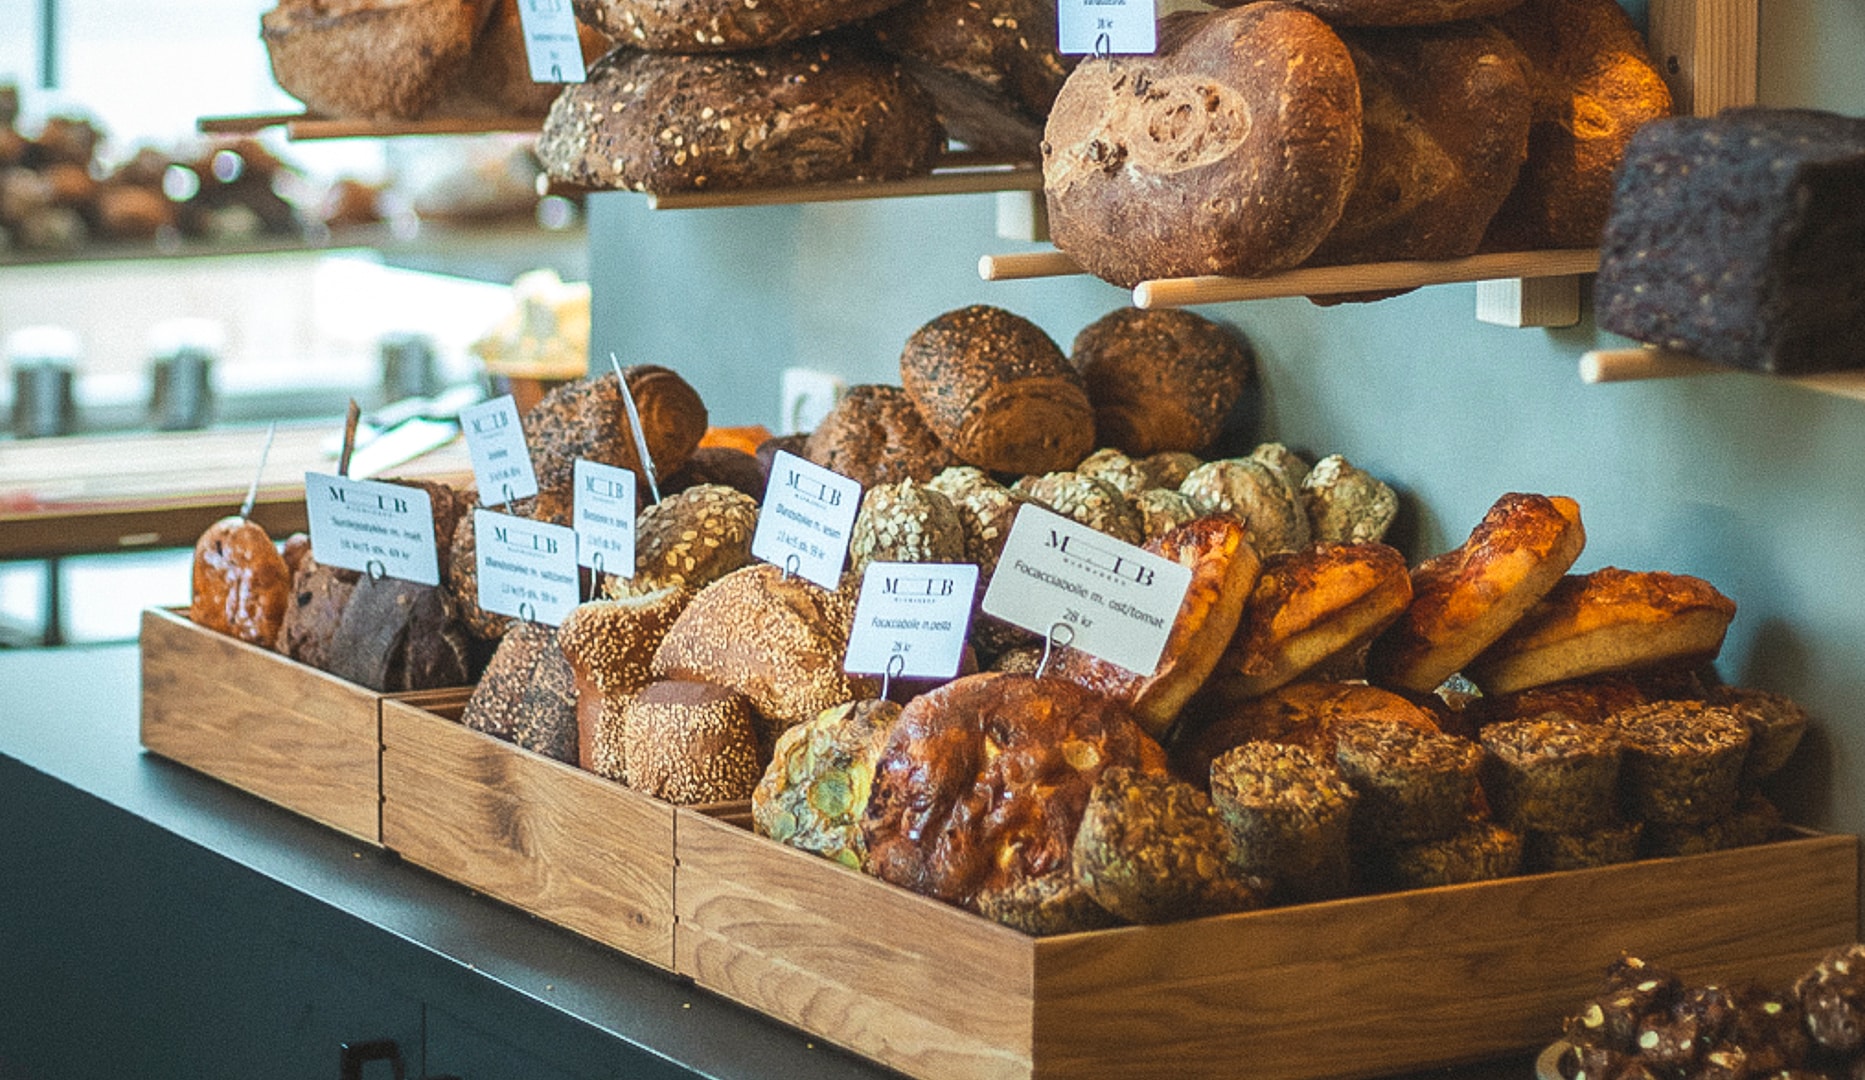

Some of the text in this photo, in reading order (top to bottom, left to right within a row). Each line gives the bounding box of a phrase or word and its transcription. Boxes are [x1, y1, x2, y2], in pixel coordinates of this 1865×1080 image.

[1062, 607, 1094, 629] 28 kr
[1108, 598, 1165, 630] ost/tomat
